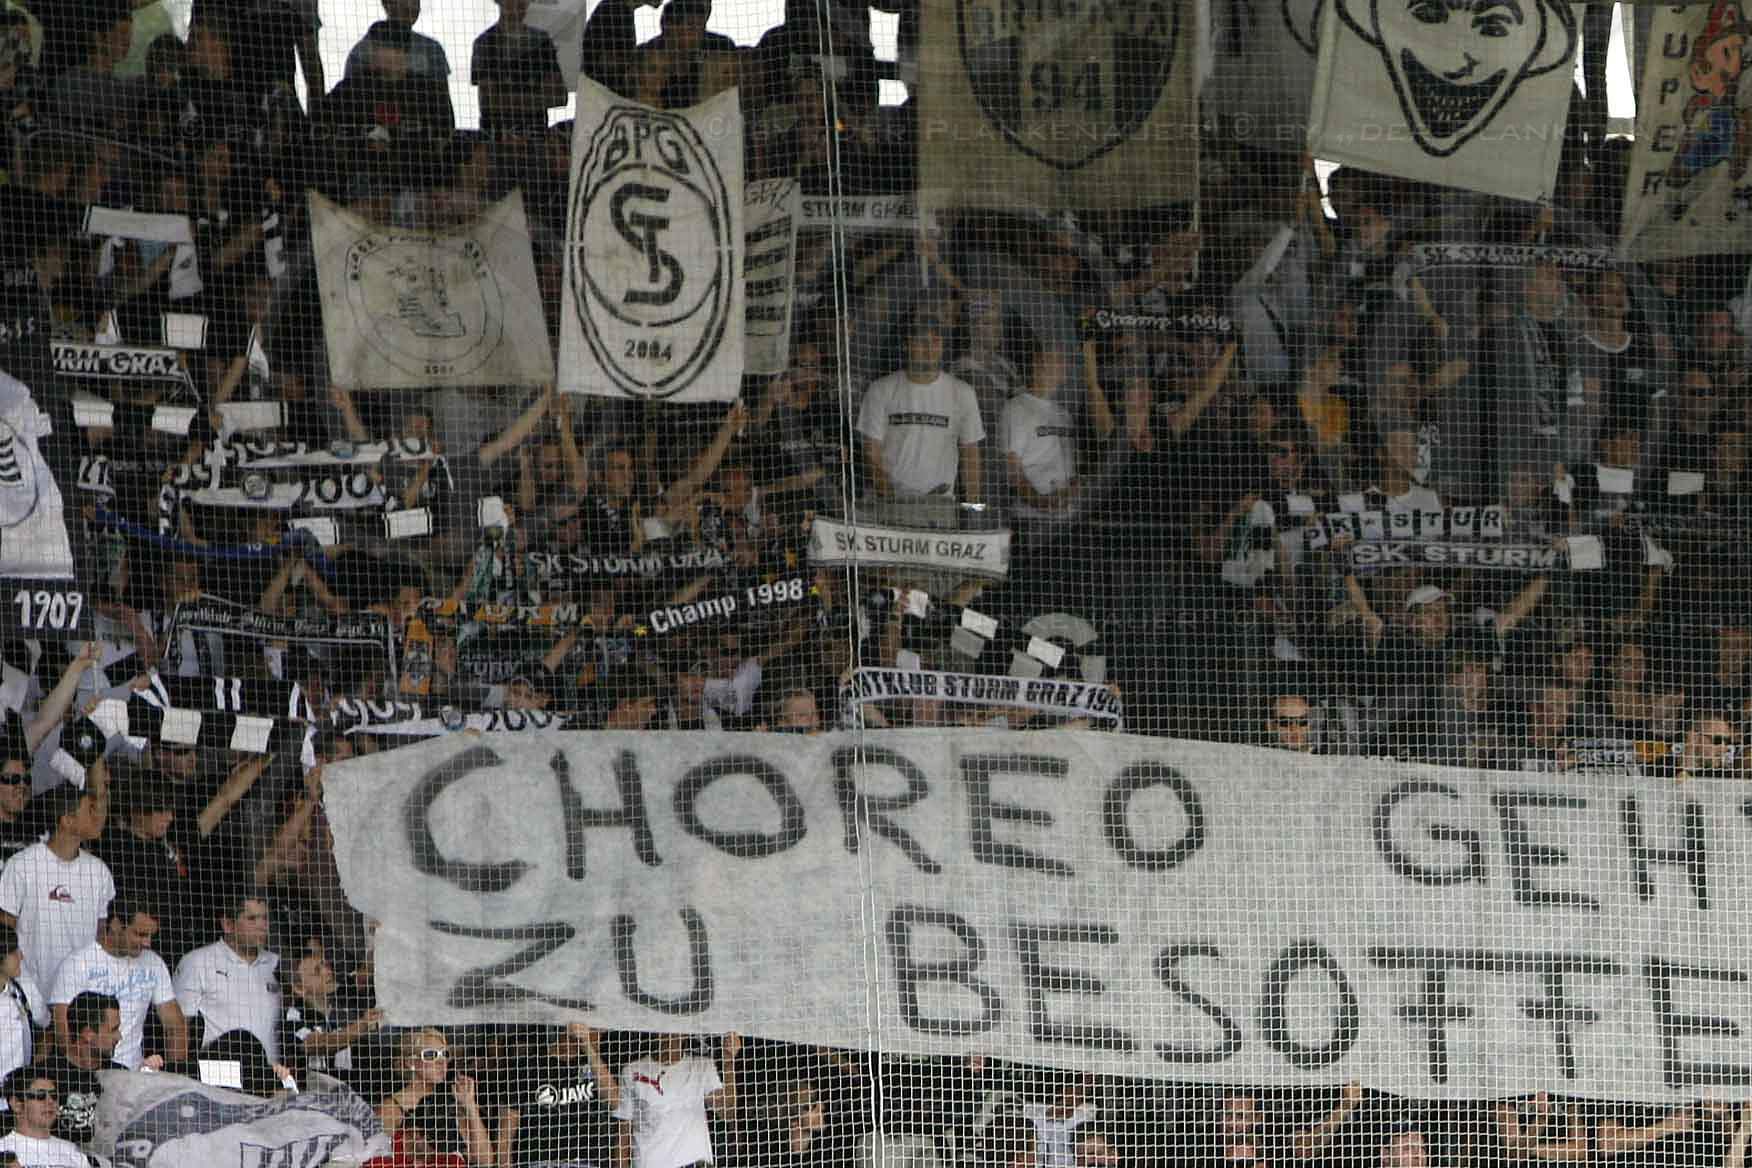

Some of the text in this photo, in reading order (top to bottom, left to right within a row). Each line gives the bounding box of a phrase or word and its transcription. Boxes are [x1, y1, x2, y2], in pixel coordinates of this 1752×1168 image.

[863, 534, 931, 556] STURM
[935, 540, 987, 561] GRAZ
[1352, 541, 1560, 570] SK STURM
[13, 589, 85, 631] 1909
[646, 577, 805, 635] Champ 1998
[943, 675, 1021, 701] STURM
[1026, 682, 1083, 704] GRAZ
[406, 744, 1207, 893] CHOREO
[430, 904, 713, 1015] ZU
